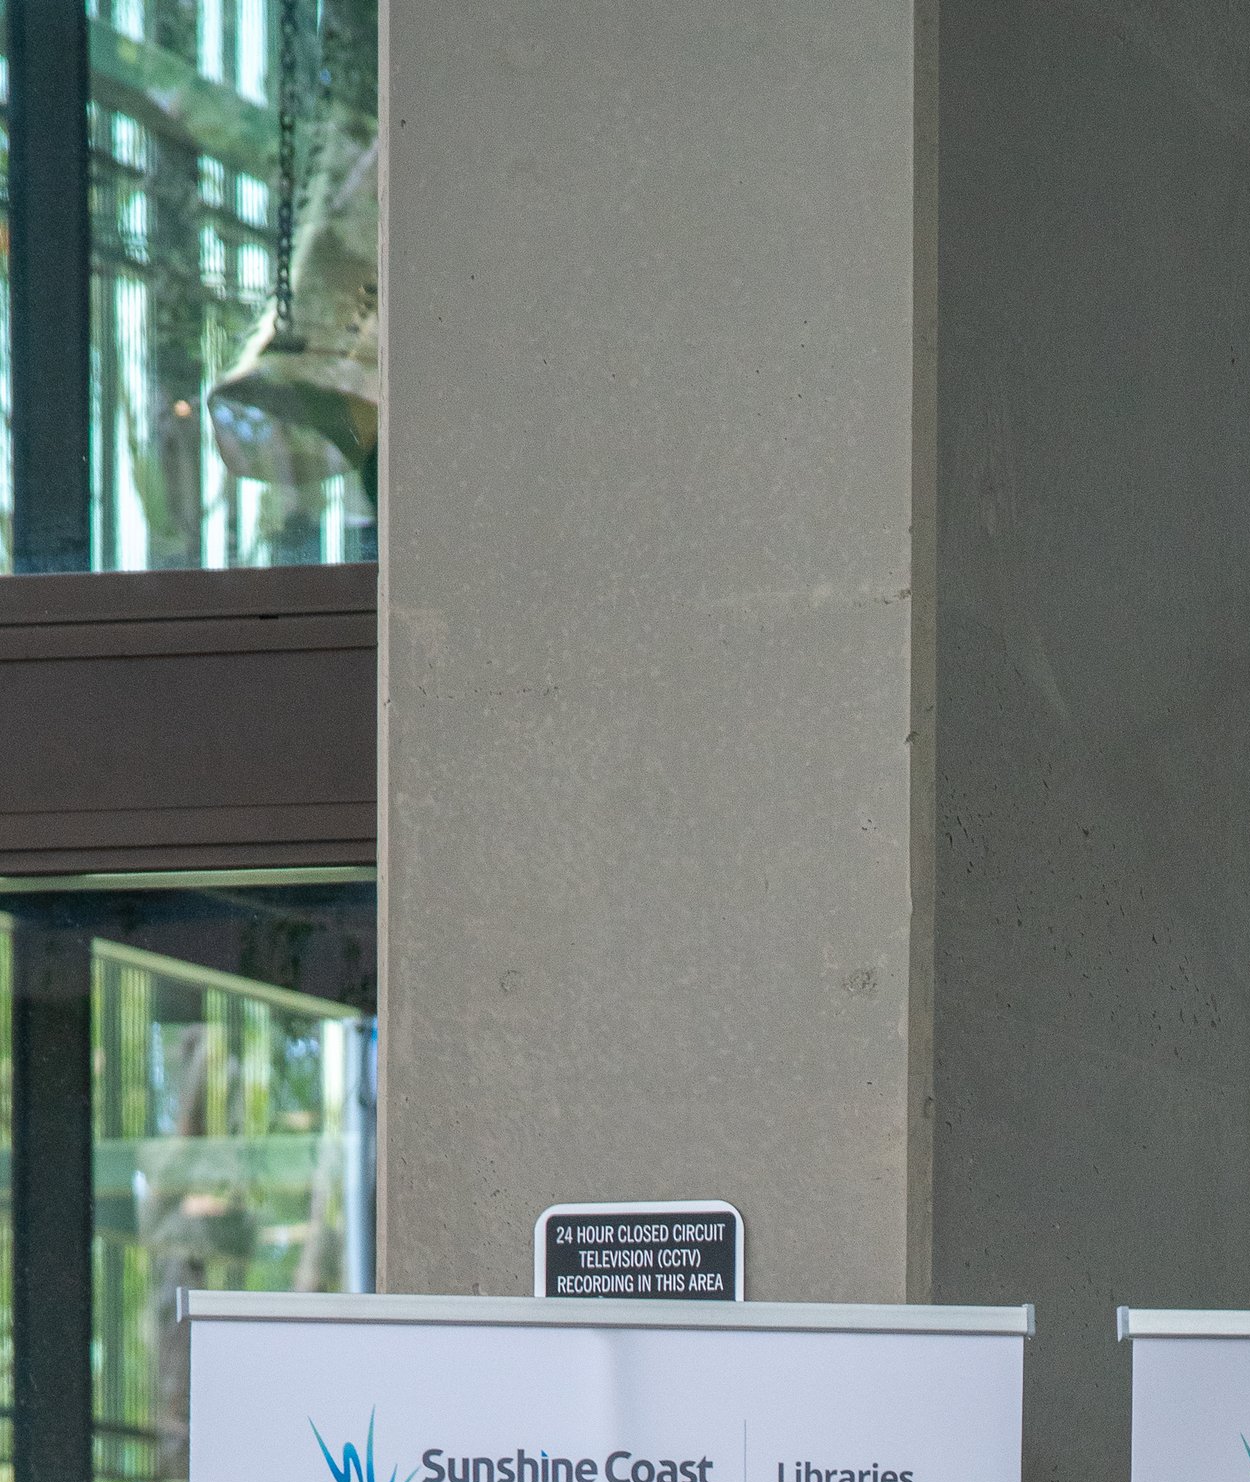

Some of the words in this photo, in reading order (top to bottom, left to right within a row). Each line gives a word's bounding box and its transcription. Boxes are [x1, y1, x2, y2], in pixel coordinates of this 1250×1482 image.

[556, 1226, 573, 1244] 24
[577, 1225, 615, 1244] HOUR
[617, 1224, 669, 1243] CLOSED
[672, 1223, 726, 1243] CIRCUIT
[579, 1249, 654, 1269] TELEVISION
[657, 1248, 702, 1269] (CCTV)
[557, 1274, 634, 1294] RECORDING
[637, 1274, 652, 1292] IN
[655, 1273, 686, 1292] THIS
[688, 1273, 724, 1291] AREA
